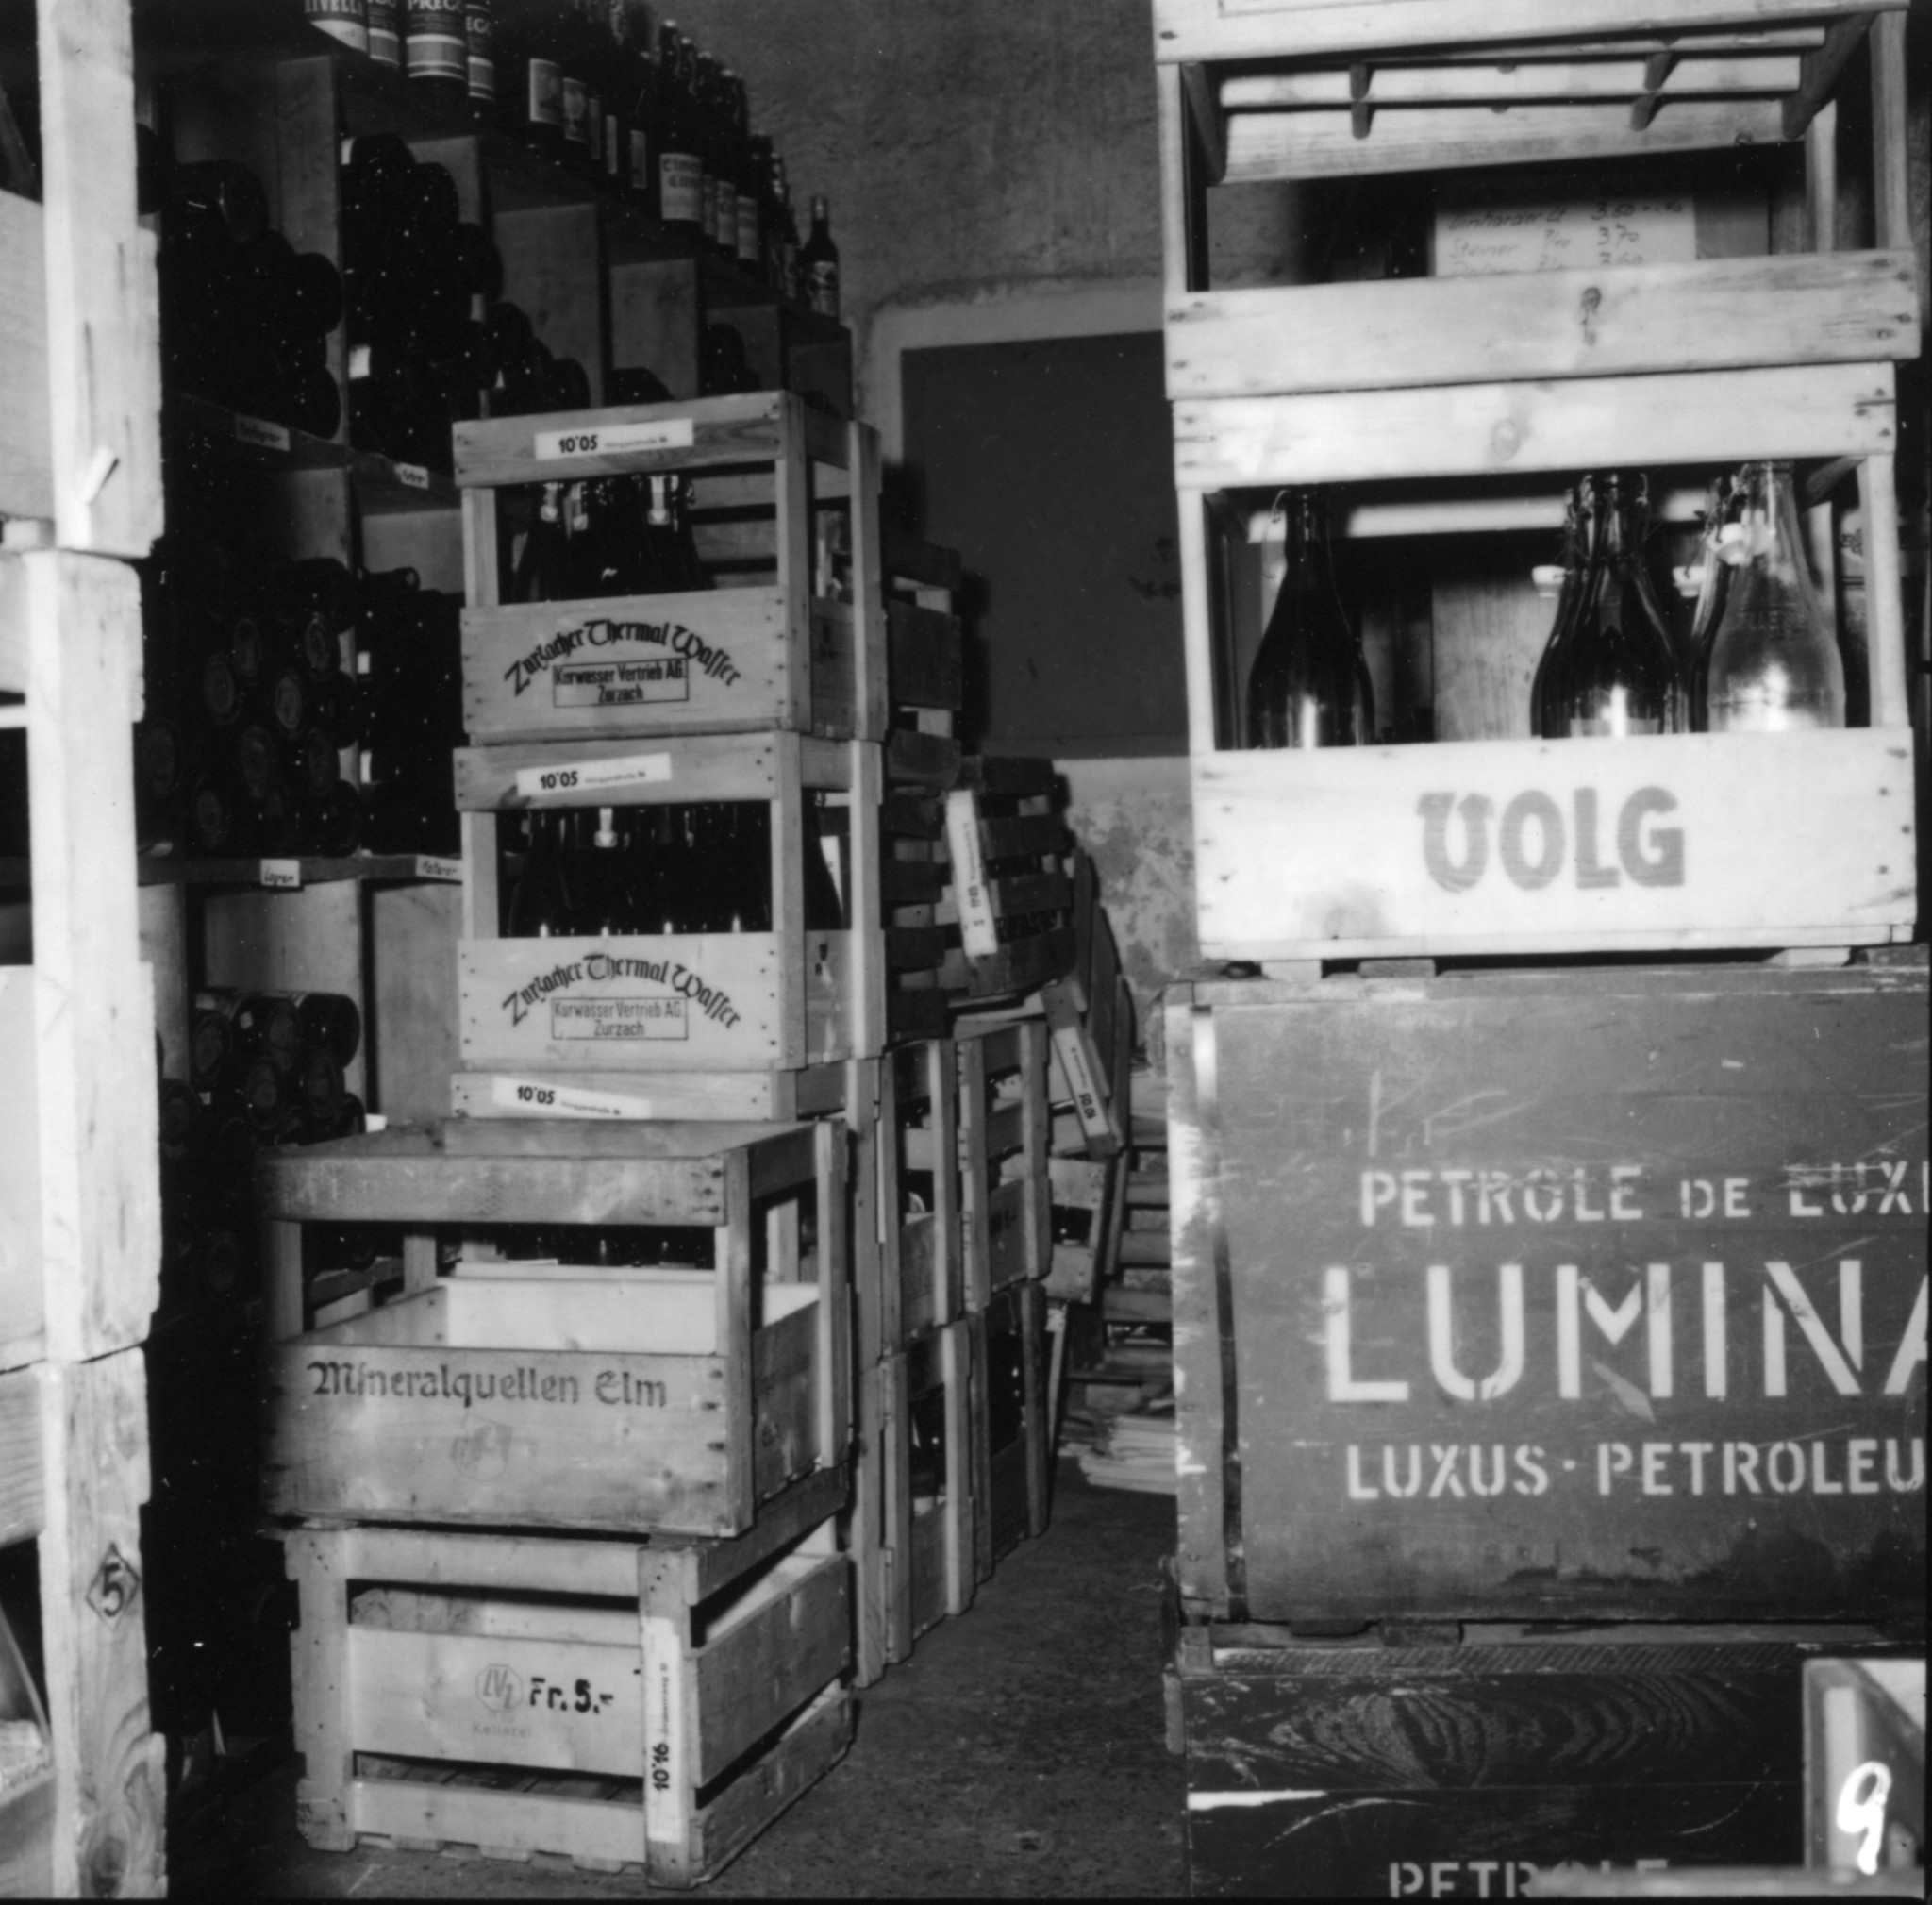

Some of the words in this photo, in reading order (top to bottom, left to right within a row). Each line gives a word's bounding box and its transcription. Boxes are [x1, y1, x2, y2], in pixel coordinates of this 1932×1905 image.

[584, 618, 670, 646] Thermal
[597, 685, 644, 704] Zurzach
[583, 953, 670, 984] Thermal
[554, 1000, 614, 1019] Kurwasser
[615, 1000, 662, 1019] Vertrieb
[593, 1019, 645, 1038] Zurzach
[1360, 1165, 1643, 1228] PETROLE
[1679, 1178, 1751, 1219] DE
[1789, 1161, 1929, 1217] LUX
[307, 1361, 580, 1409] Mineralquellen
[594, 1368, 668, 1409] Elm
[1347, 1442, 1549, 1500] LUXUS
[102, 1562, 125, 1618] 5
